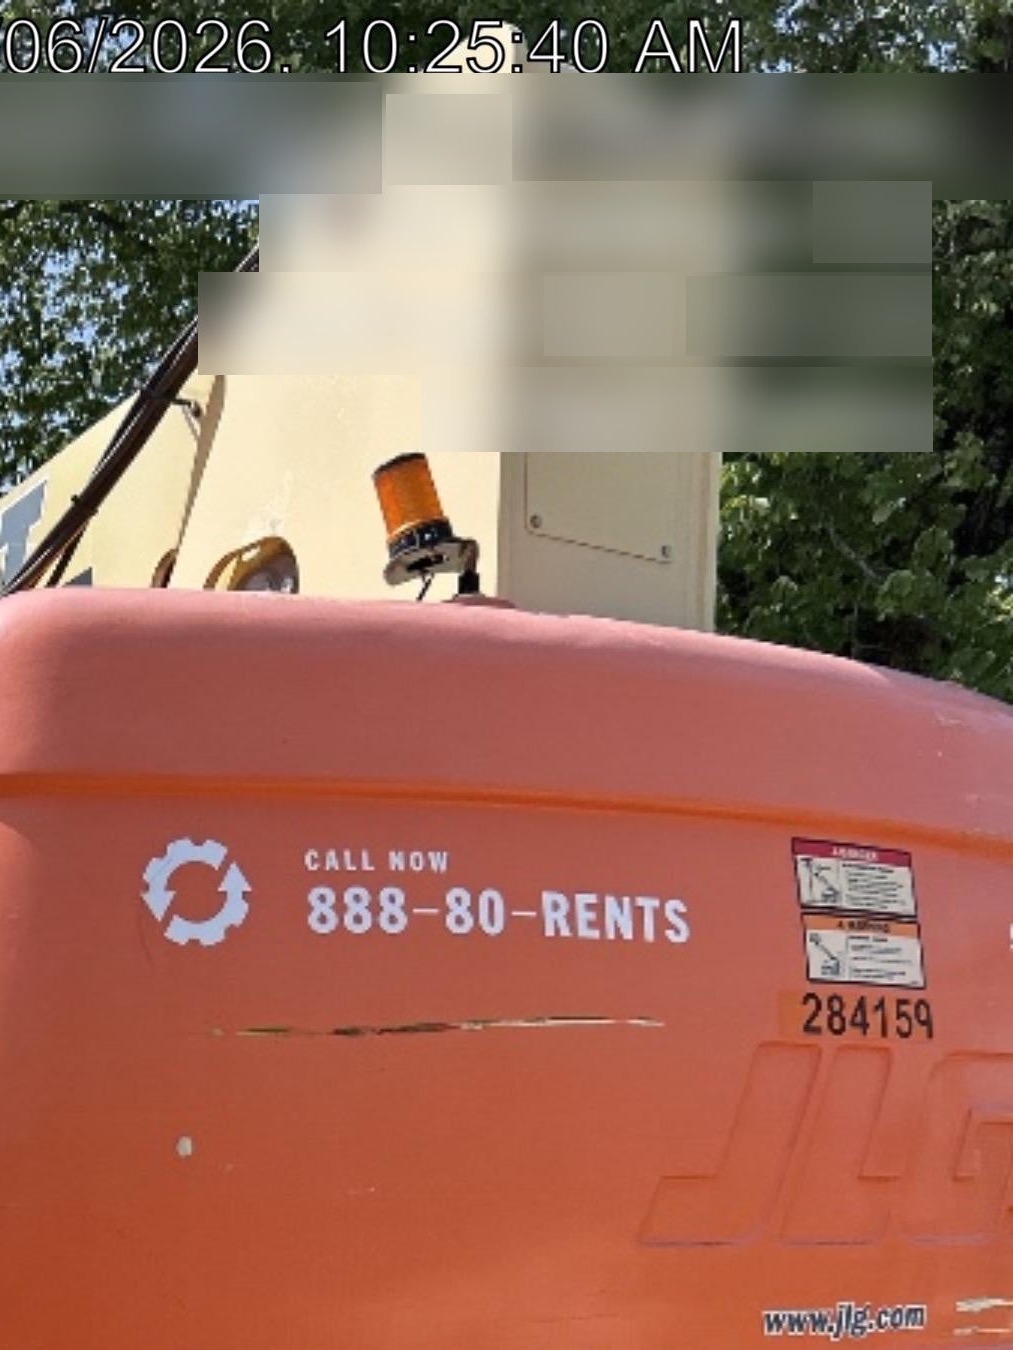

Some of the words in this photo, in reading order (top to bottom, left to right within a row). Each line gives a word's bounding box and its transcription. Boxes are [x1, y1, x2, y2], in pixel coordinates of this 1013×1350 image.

[304, 848, 375, 872] CALL
[389, 850, 449, 874] NOW
[306, 886, 690, 944] 888-80-RENTS
[802, 992, 934, 1039] 284159
[637, 1040, 1013, 1245] JLG
[764, 1303, 926, 1338] www.jlg.com
